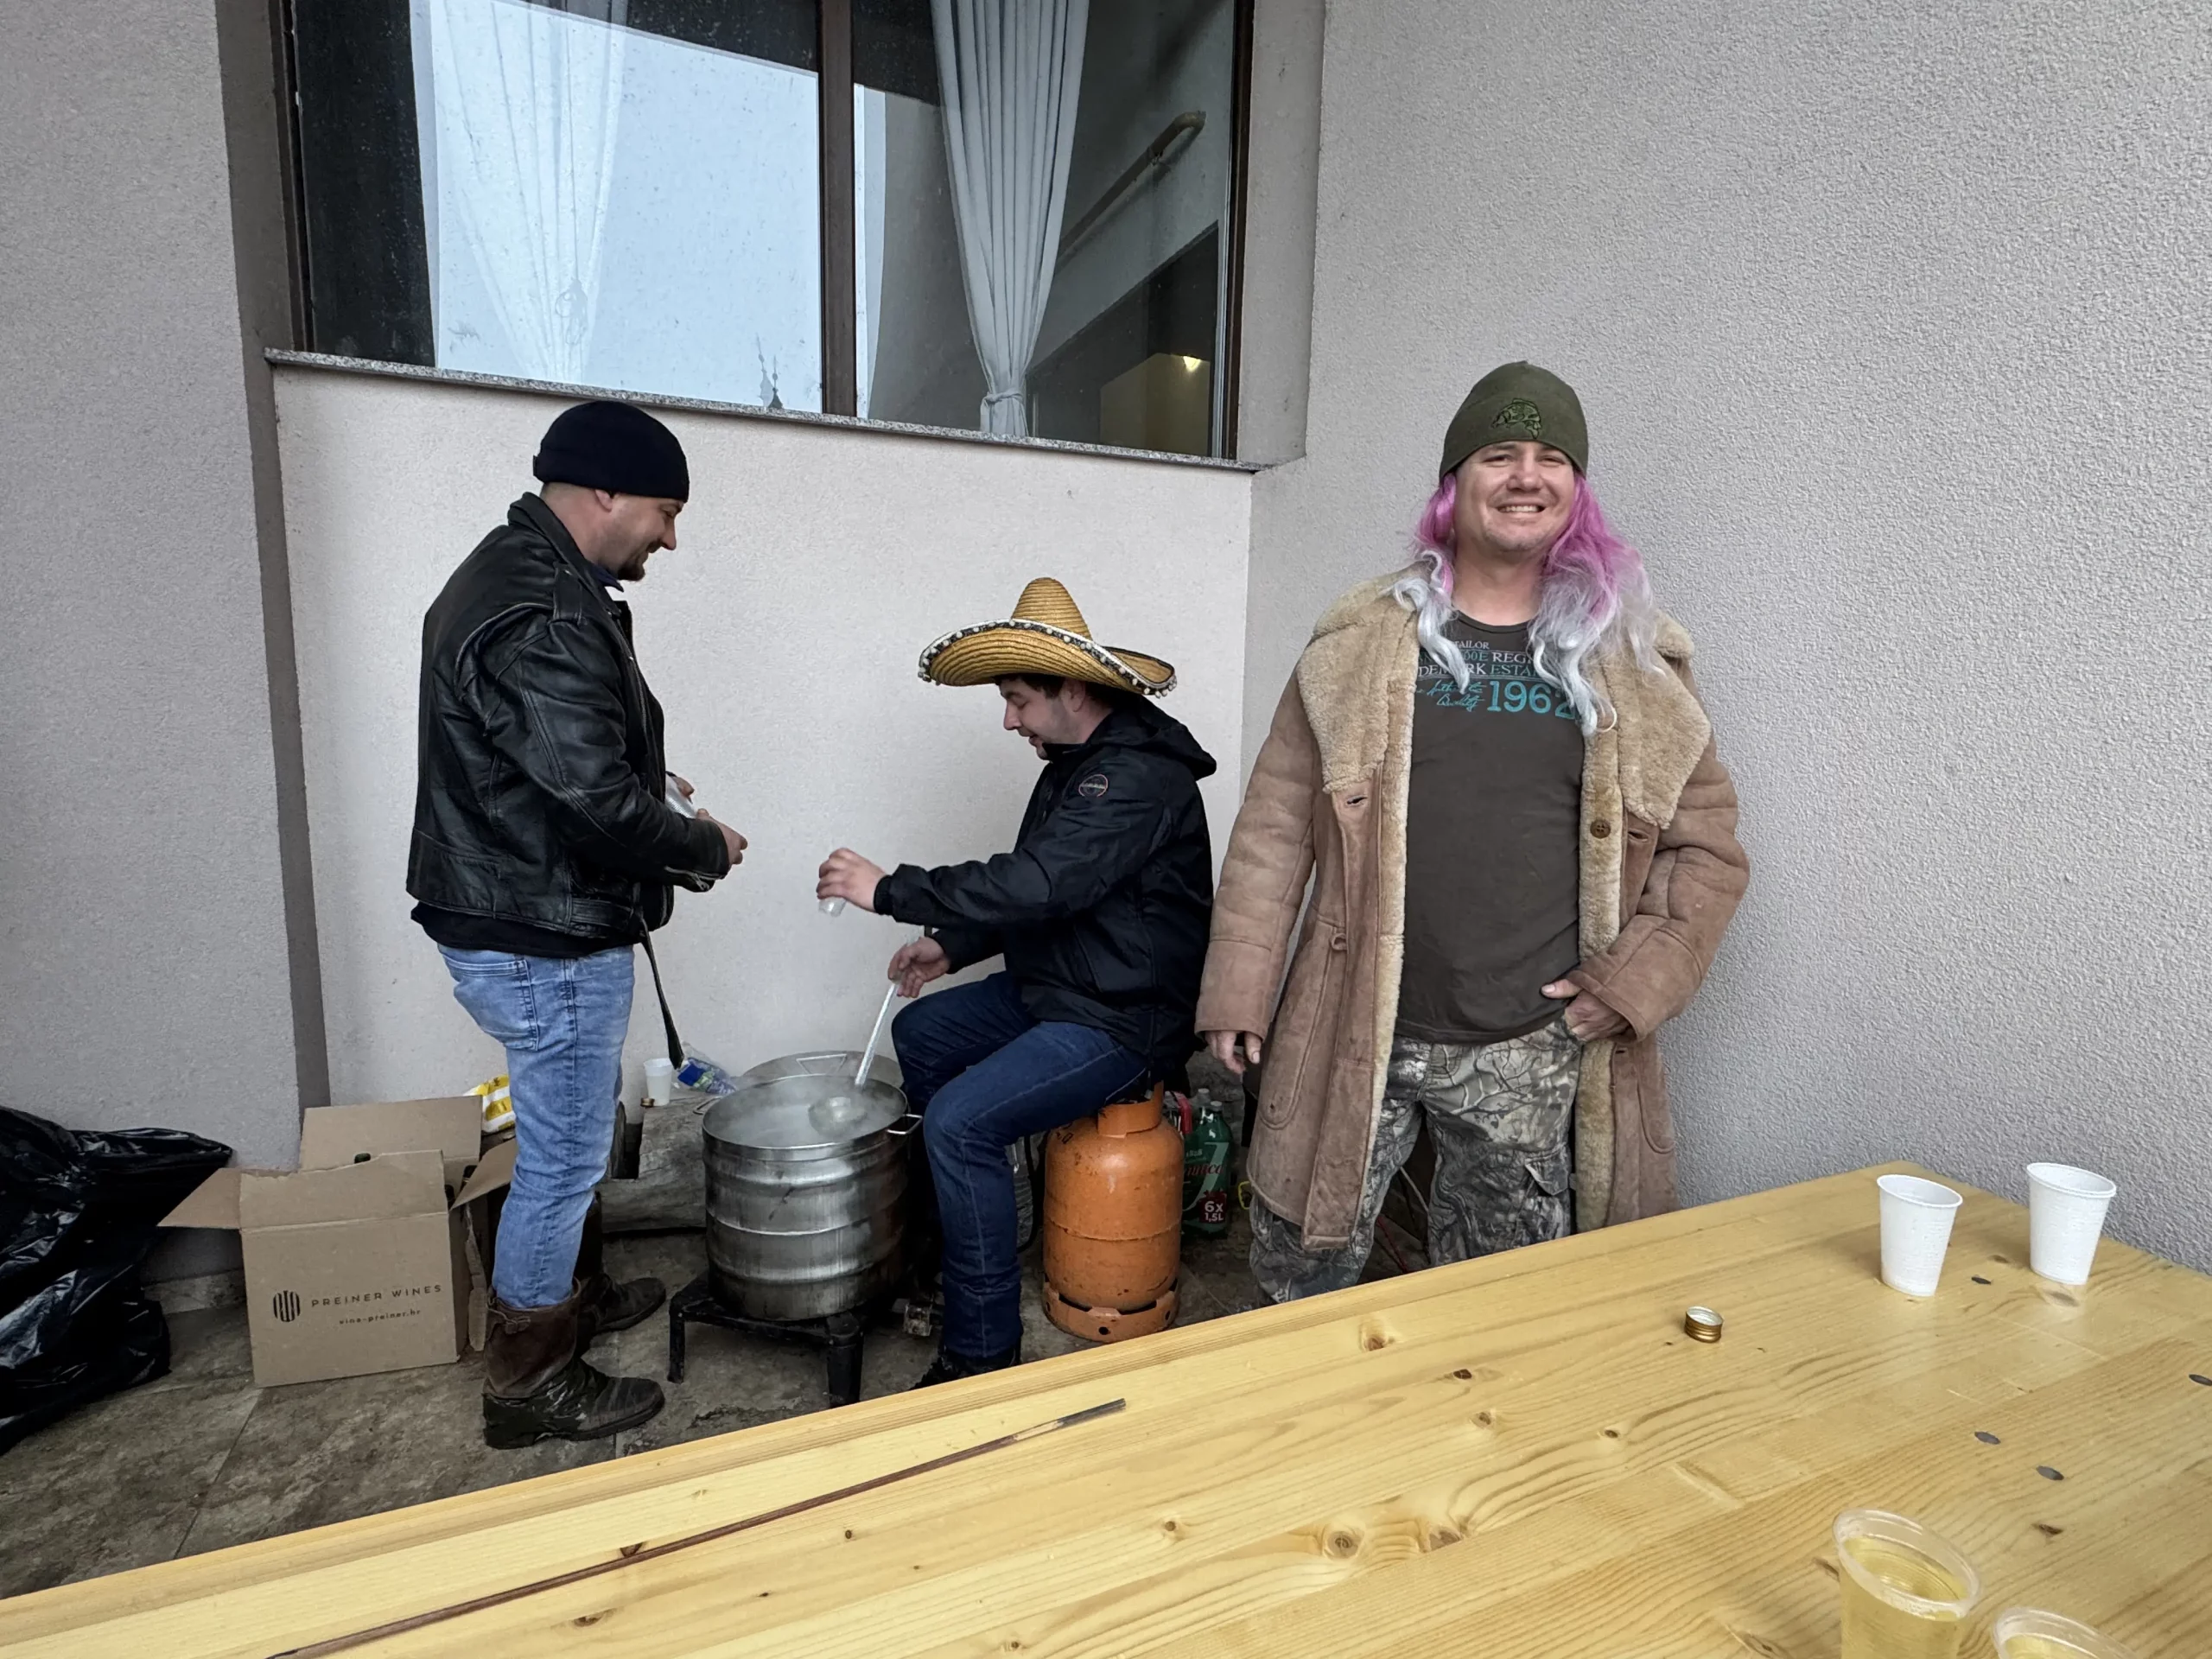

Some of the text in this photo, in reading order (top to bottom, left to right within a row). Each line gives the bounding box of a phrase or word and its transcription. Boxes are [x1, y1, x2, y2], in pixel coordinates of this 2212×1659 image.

[1205, 1212, 1224, 1223] 1,5L
[311, 1284, 442, 1307] PREINER WINES
